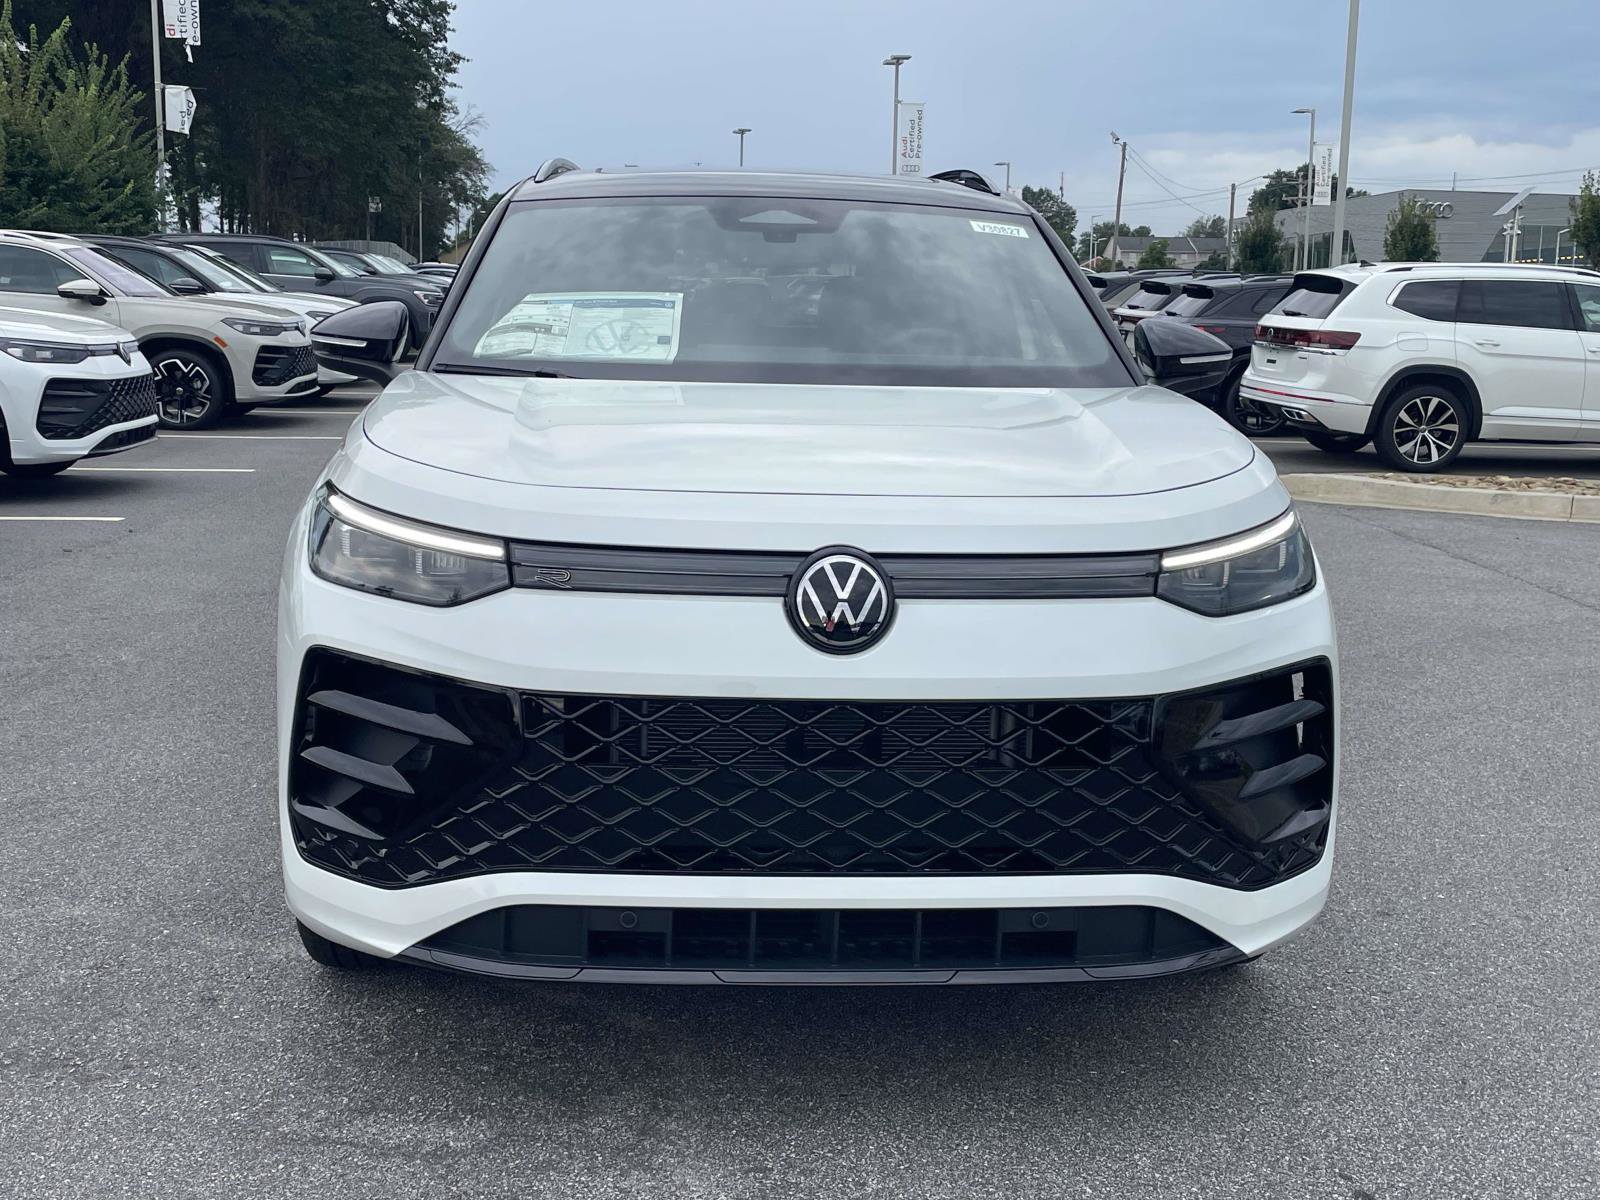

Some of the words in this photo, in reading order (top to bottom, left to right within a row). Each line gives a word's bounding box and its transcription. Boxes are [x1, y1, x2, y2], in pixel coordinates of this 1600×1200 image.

[190, 0, 200, 46] e-own
[908, 119, 916, 159] Certified
[915, 109, 923, 159] Pre-owned
